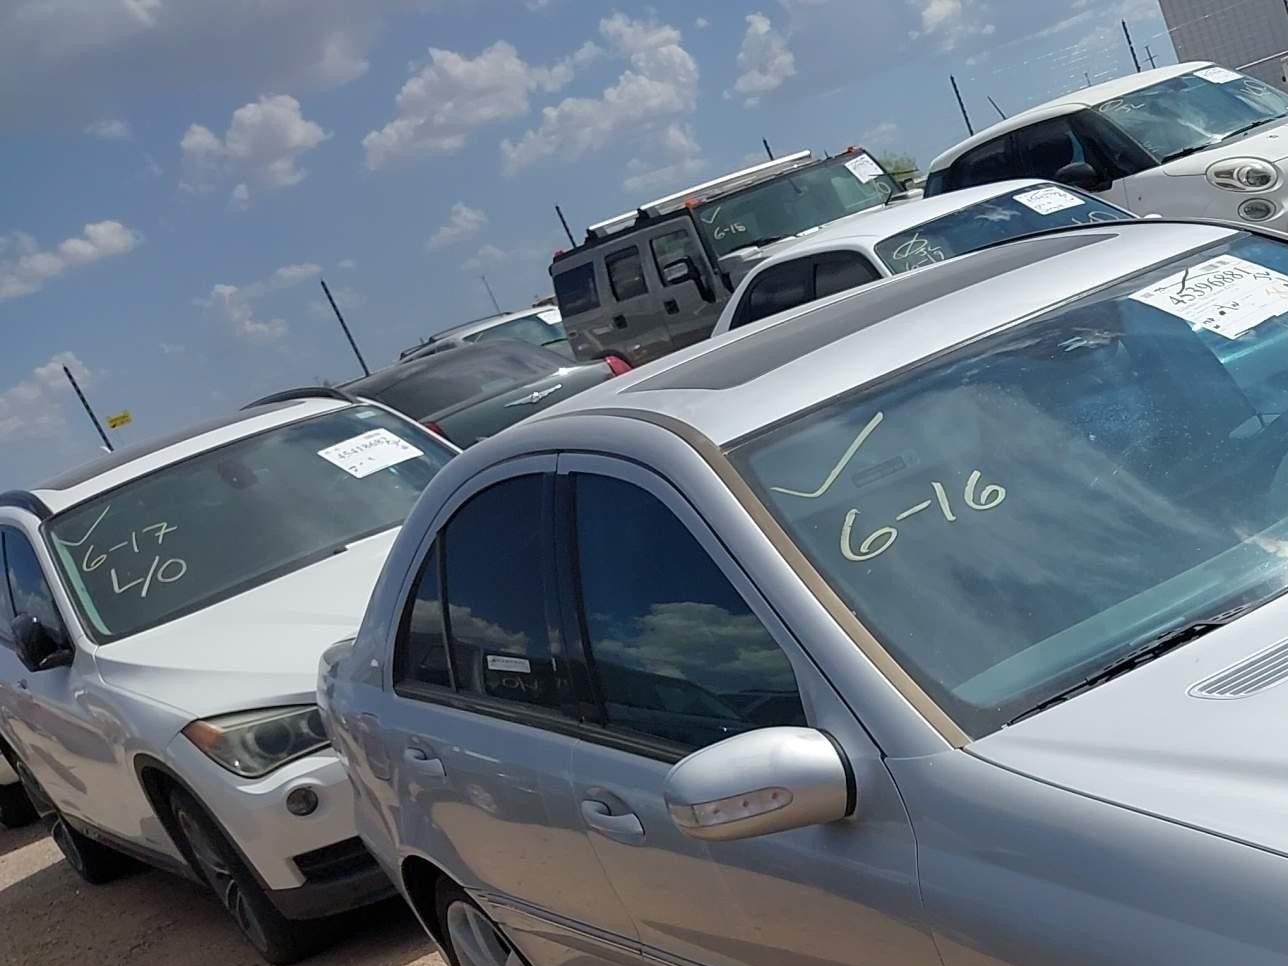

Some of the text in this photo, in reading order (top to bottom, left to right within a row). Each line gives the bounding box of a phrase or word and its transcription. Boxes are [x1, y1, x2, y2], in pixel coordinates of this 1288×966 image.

[1168, 267, 1251, 306] 45396881
[840, 470, 1006, 561] 6-16
[82, 521, 178, 572] 6-17
